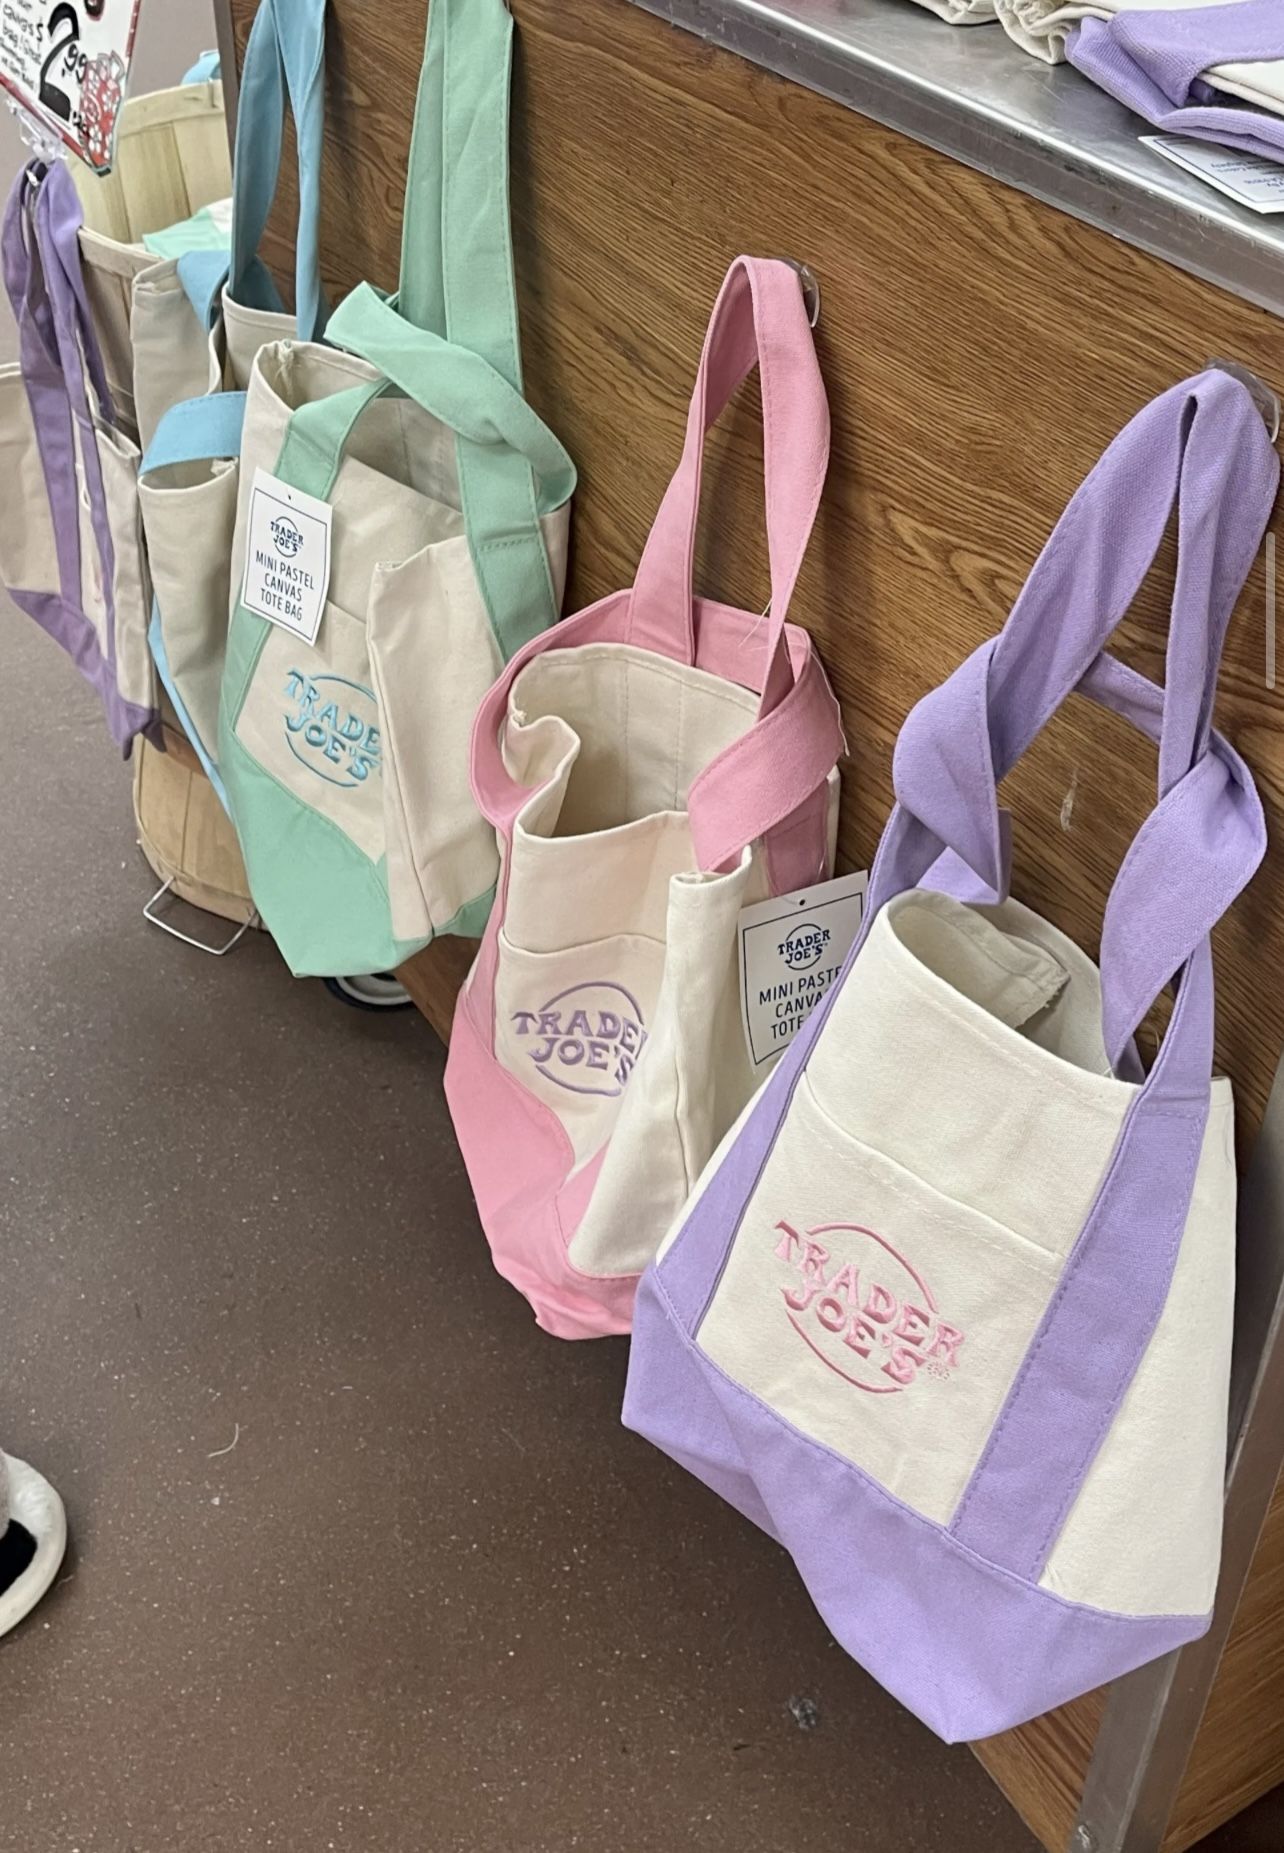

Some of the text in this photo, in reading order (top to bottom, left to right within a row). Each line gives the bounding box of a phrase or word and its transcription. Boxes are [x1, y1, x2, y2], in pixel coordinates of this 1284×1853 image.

[270, 520, 304, 546] TRADER
[273, 534, 299, 553] JOE'S
[256, 549, 315, 590] MINI PASTEL
[264, 572, 302, 603] CANVAS
[260, 587, 303, 622] TOTE BAG
[284, 670, 382, 758] TRADE
[284, 713, 379, 781] JOE'S
[777, 929, 831, 956] TRADER
[784, 943, 824, 965] JOE'S
[759, 981, 793, 1006] MINI
[775, 988, 826, 1019] CANVA
[527, 1037, 634, 1086] JOE'S
[774, 1220, 965, 1368] TRADER
[779, 1280, 928, 1385] JOE'S
